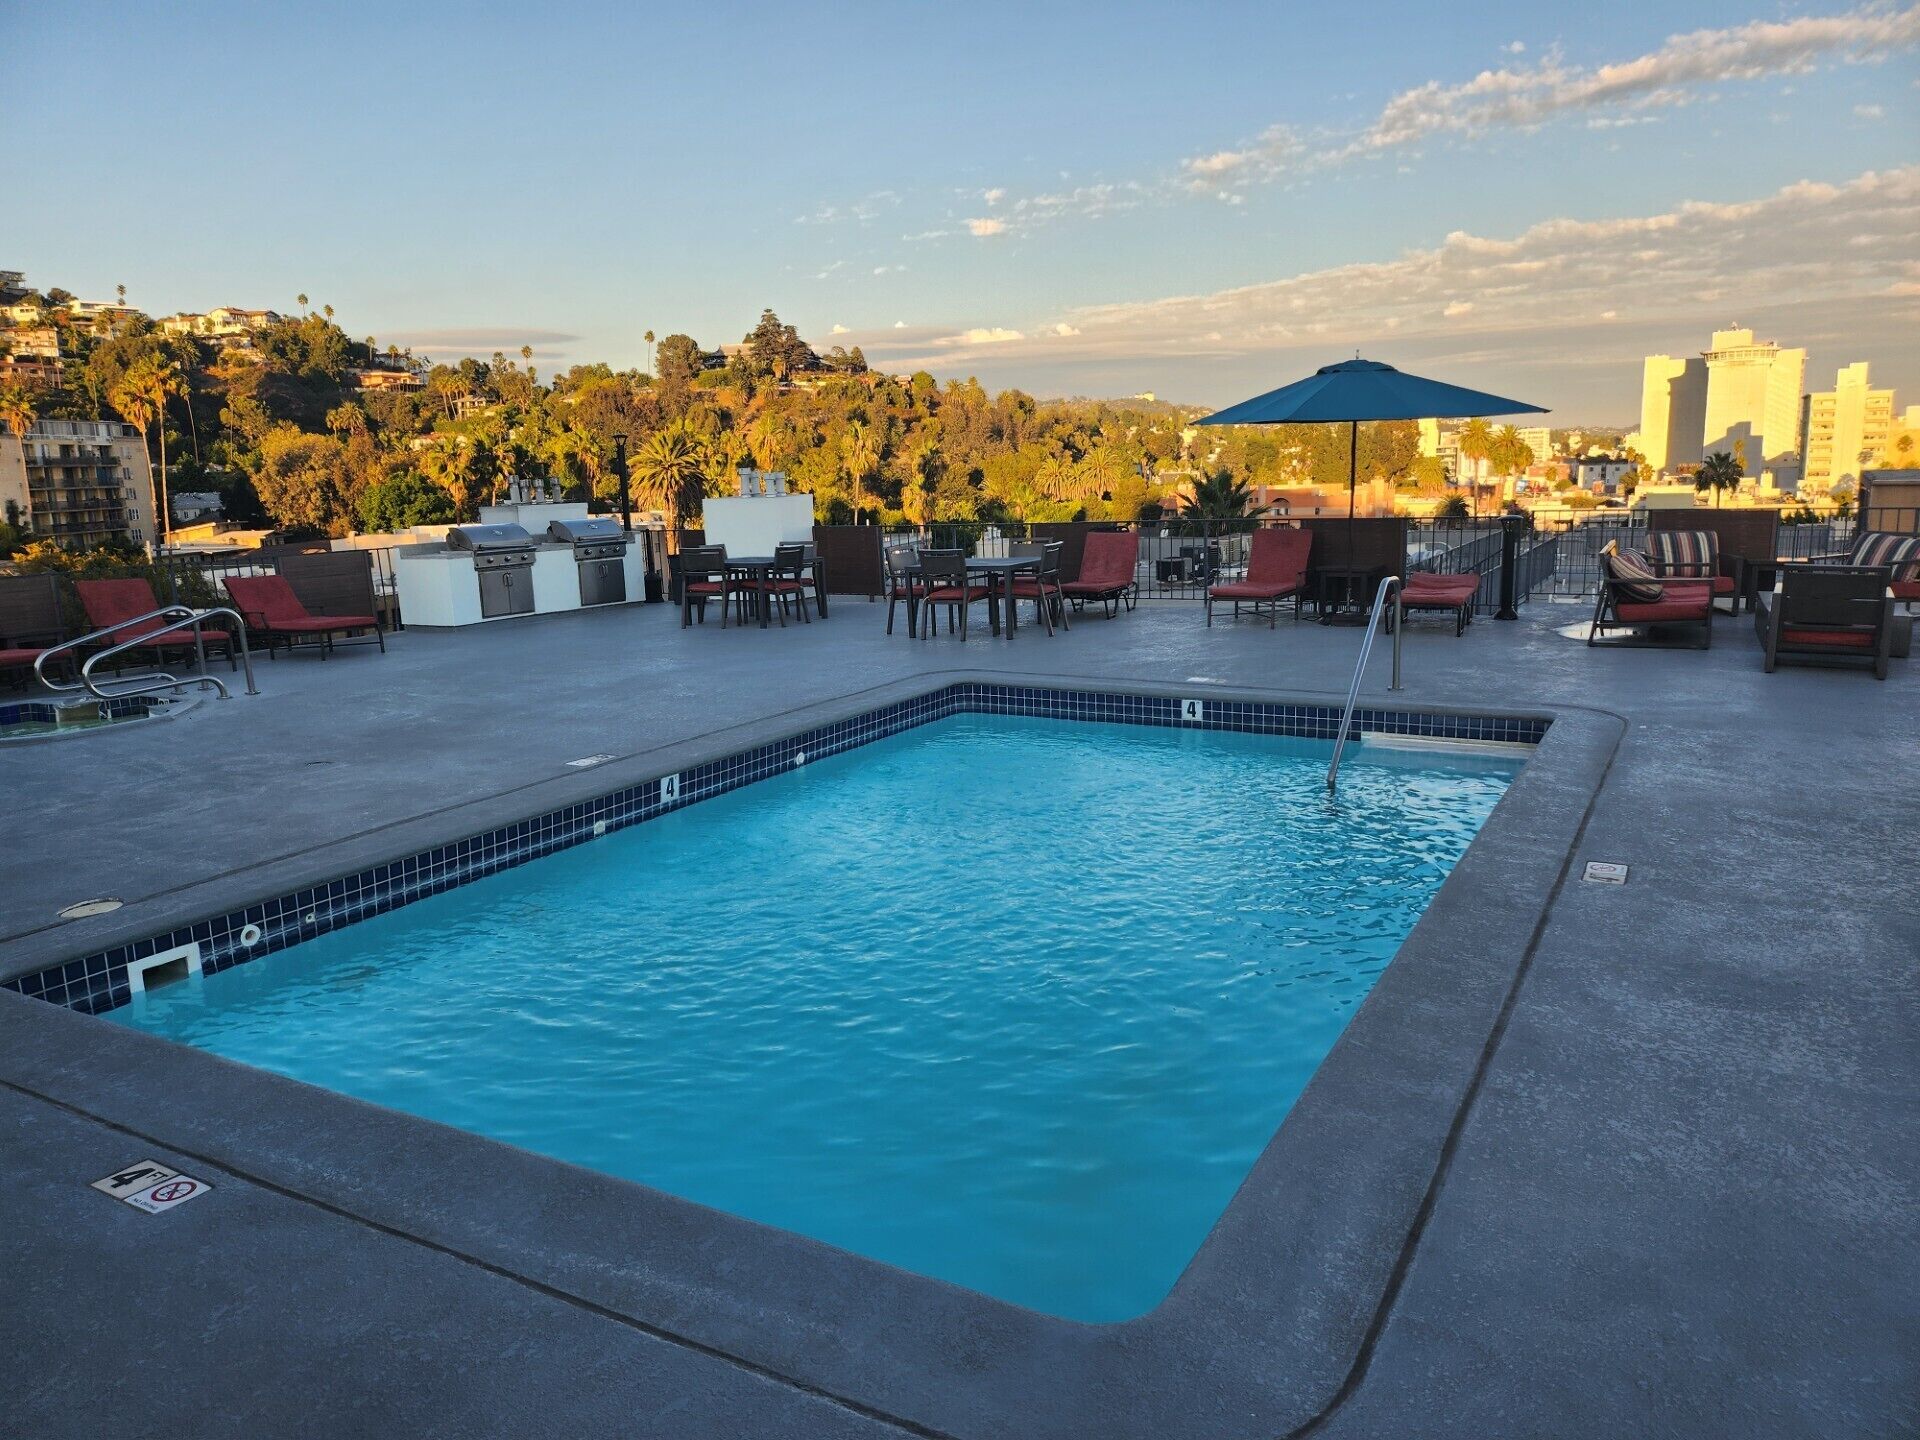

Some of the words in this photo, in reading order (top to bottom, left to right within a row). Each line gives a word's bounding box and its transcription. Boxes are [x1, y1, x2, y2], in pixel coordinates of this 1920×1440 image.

[1187, 701, 1196, 718] 4
[666, 777, 674, 798] 4
[110, 1167, 156, 1188] 4
[146, 1171, 169, 1182] FT
